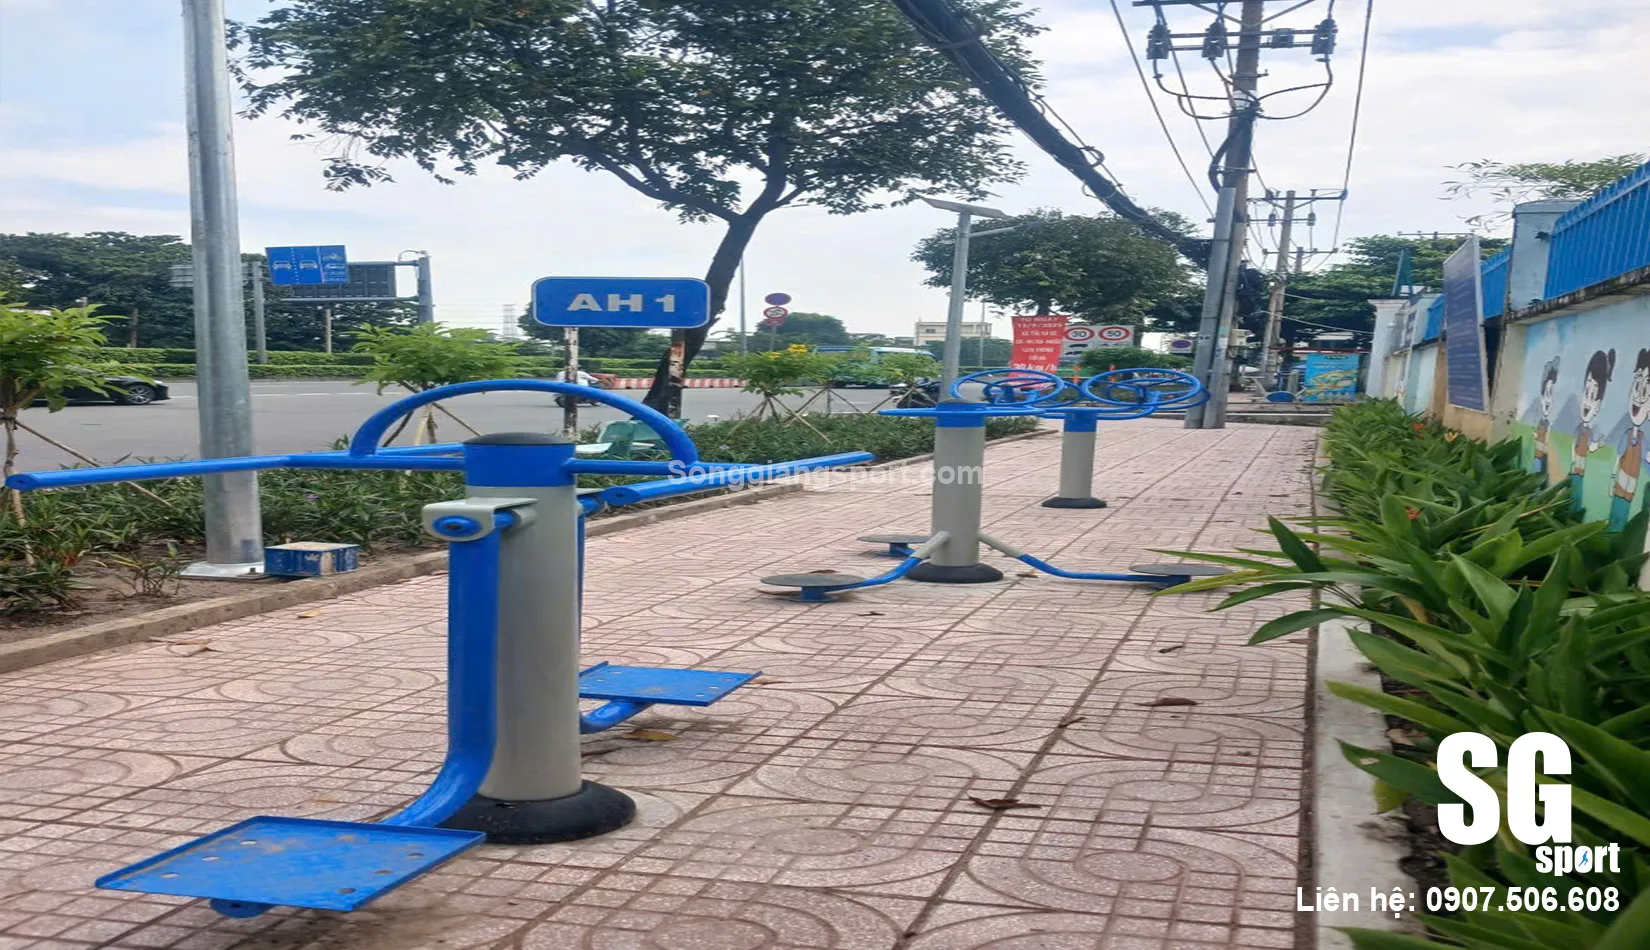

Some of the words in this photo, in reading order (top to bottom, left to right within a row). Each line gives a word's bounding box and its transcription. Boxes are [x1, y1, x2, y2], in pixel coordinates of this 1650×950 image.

[567, 293, 643, 312] AH
[655, 294, 675, 313] 1
[1072, 330, 1087, 338] 30
